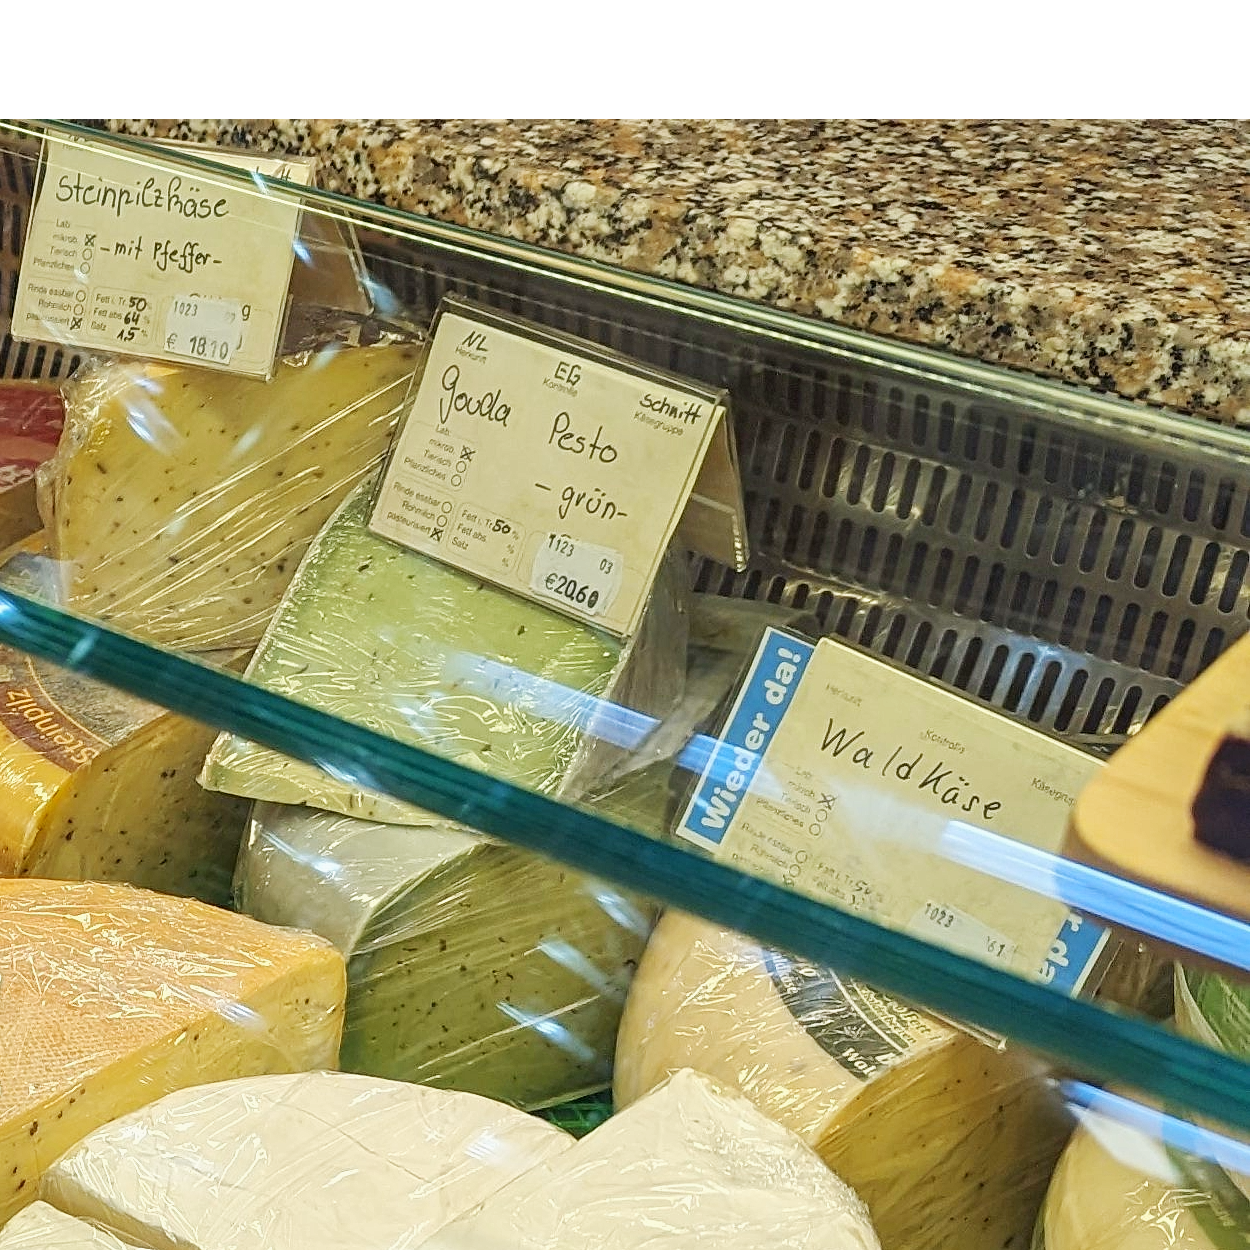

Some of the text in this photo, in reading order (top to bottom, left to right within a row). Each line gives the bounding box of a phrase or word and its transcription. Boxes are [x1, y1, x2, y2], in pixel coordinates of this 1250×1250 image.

[55, 172, 230, 219] Steinpilzkäse
[128, 295, 148, 312] 50
[173, 300, 199, 318] 1023
[461, 330, 489, 352] NL
[553, 361, 582, 386] EG
[548, 411, 619, 463] Pesto
[491, 518, 511, 535] 50
[599, 558, 614, 576] 03
[5, 687, 101, 765] Steinpilz
[700, 711, 771, 830] Wieder
[763, 647, 802, 706] da!
